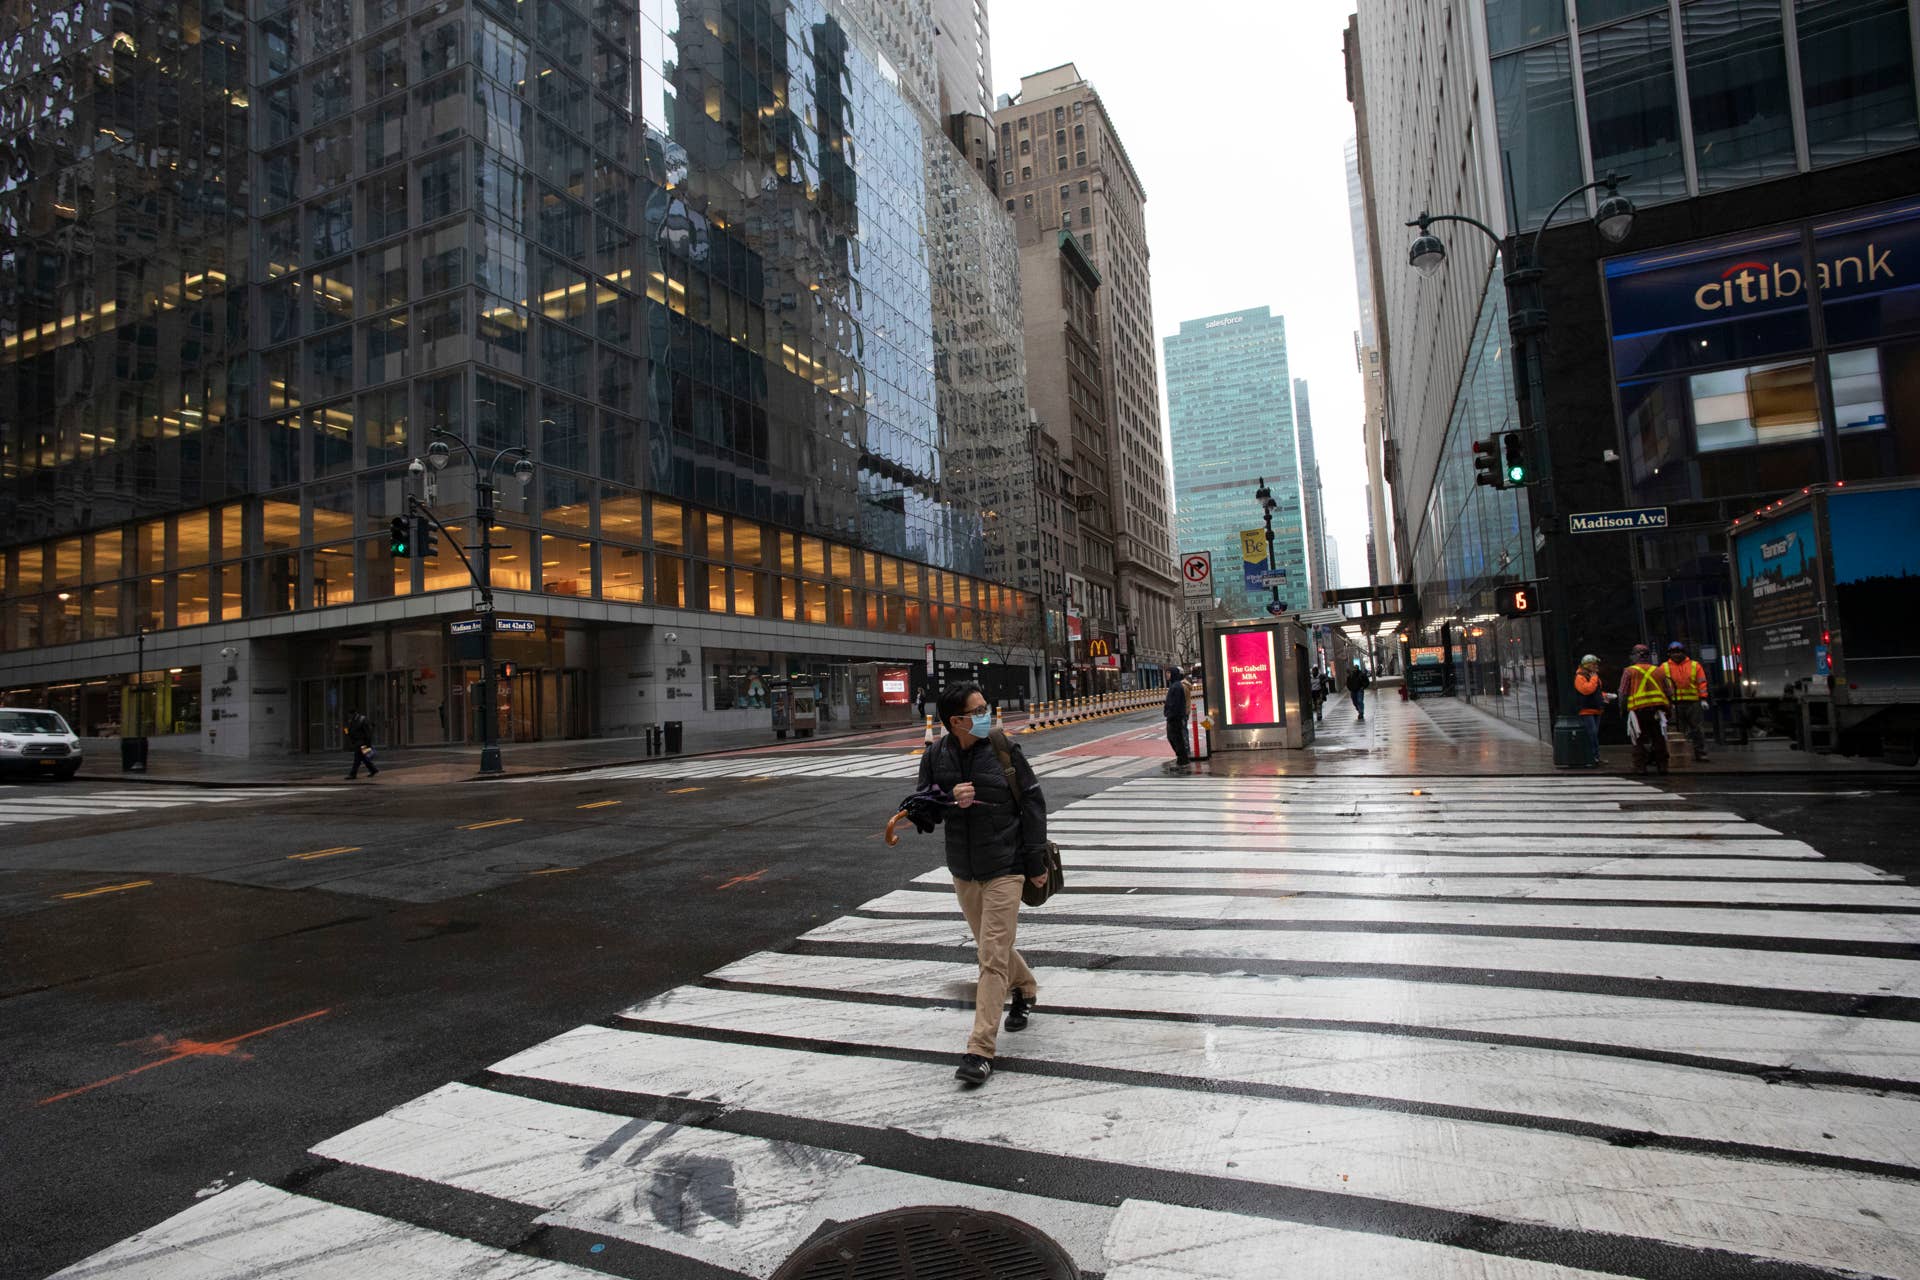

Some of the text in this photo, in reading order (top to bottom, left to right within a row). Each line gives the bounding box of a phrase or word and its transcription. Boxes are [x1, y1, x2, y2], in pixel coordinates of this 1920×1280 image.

[1695, 244, 1895, 311] citibank
[1205, 317, 1243, 329] salesforce
[1573, 514, 1664, 530] Madison Ave
[1245, 538, 1264, 554] Be
[498, 621, 533, 630] East 42nd St
[1232, 665, 1243, 673] The
[1242, 673, 1257, 681] MBA
